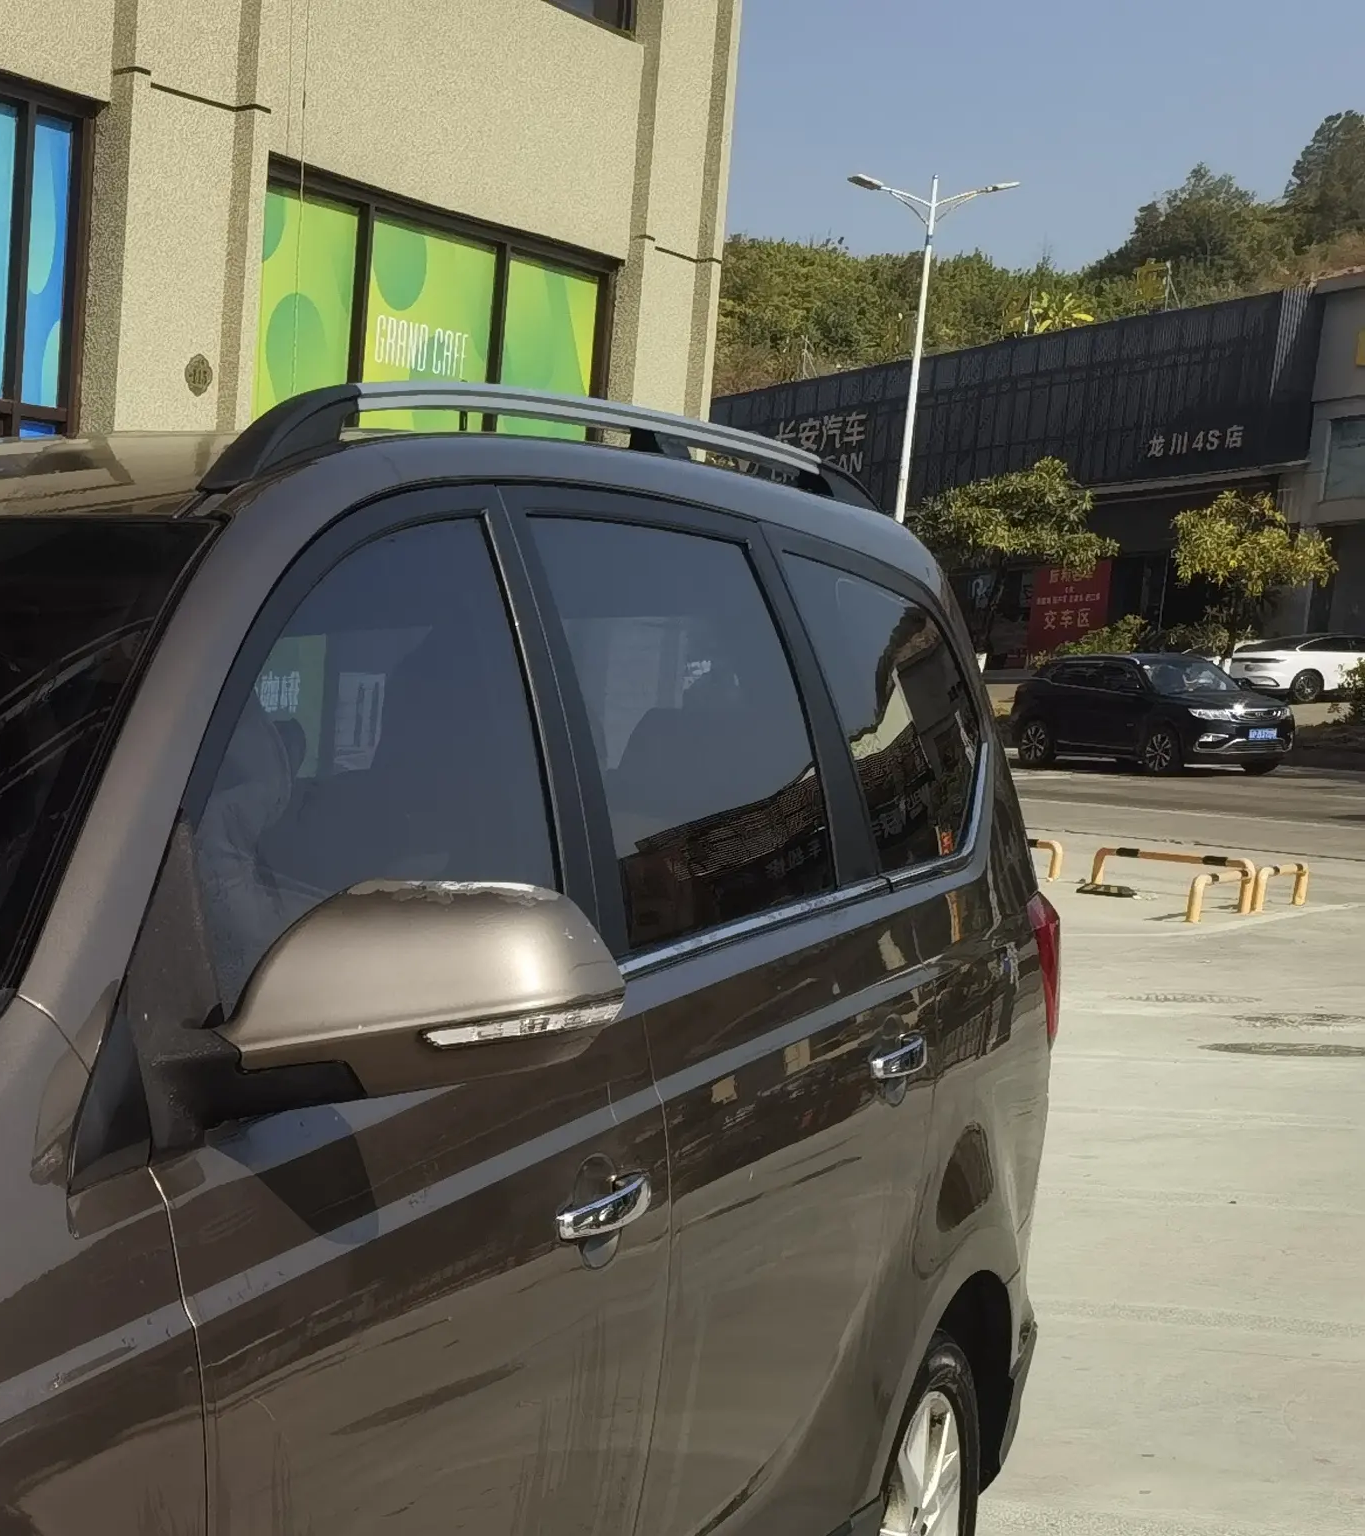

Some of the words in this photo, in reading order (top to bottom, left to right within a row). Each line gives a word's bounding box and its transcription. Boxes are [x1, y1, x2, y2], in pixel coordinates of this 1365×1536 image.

[374, 314, 429, 371] GRAND
[774, 411, 868, 452] 长安汽车
[1043, 608, 1091, 630] 交车区
